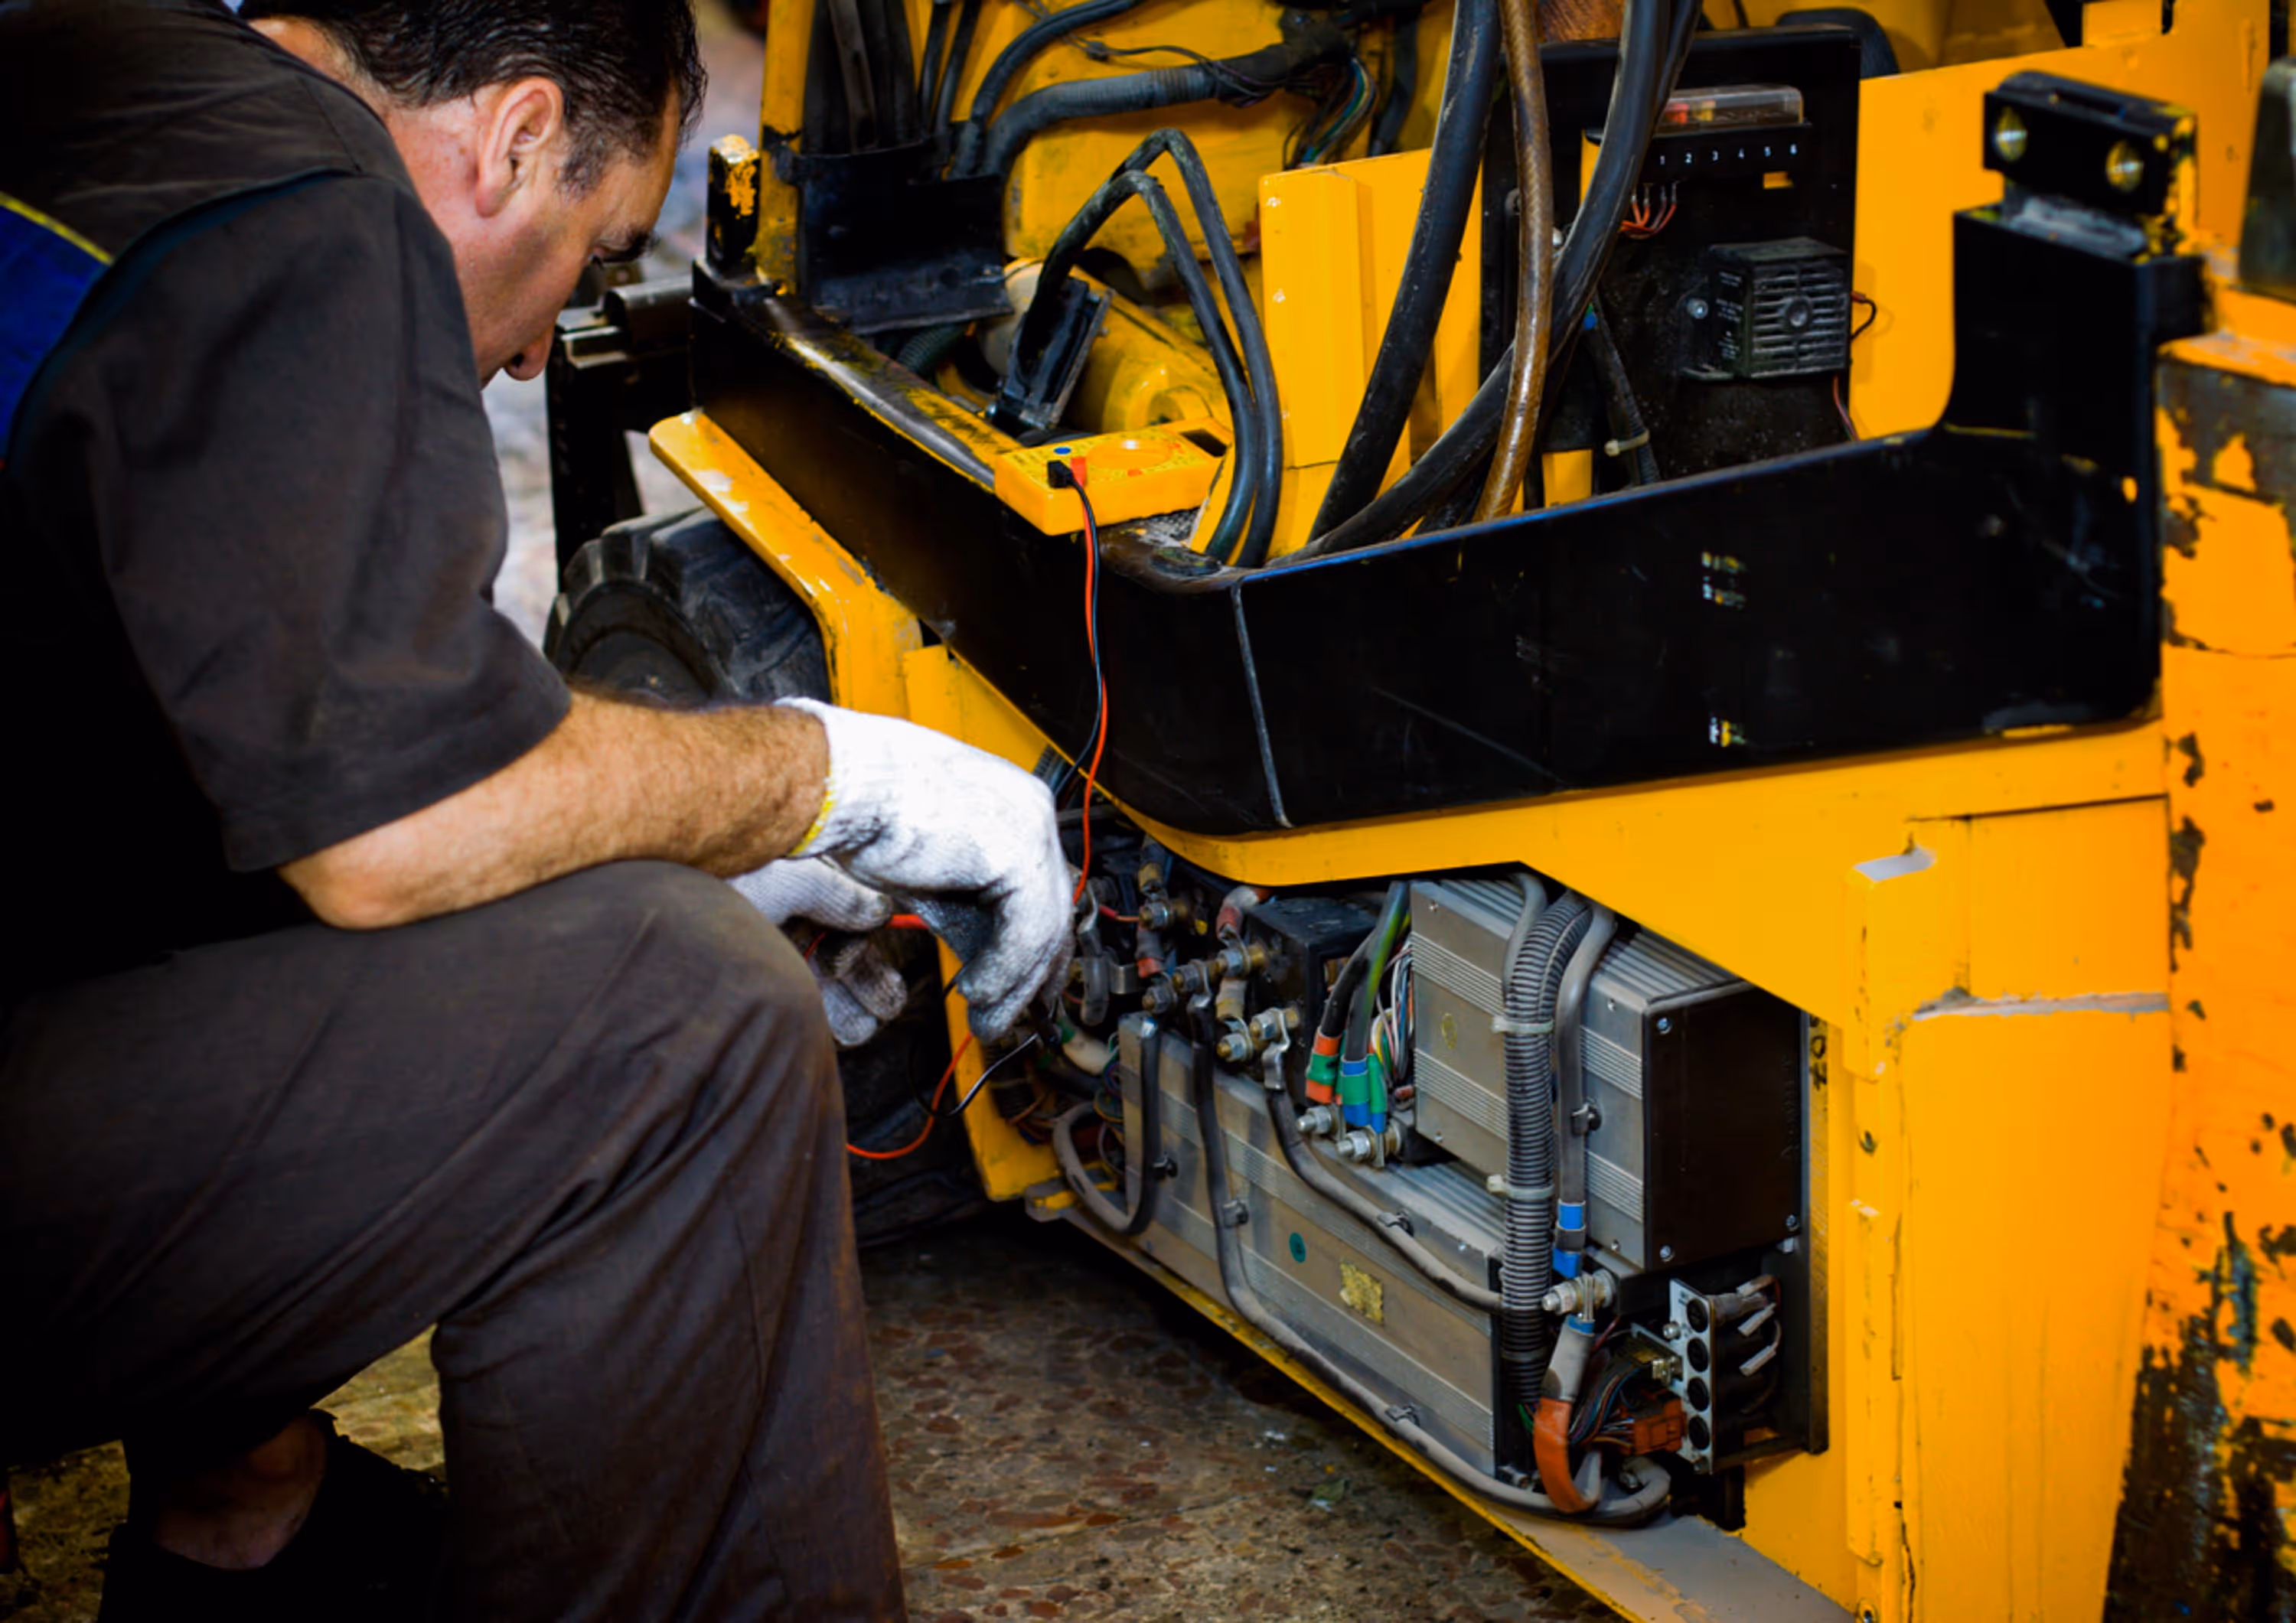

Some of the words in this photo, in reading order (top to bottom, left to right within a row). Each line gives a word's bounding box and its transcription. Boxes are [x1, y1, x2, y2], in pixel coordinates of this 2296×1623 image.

[1659, 155, 1665, 165] 1
[1684, 152, 1692, 164] 2
[1711, 151, 1719, 161] 3
